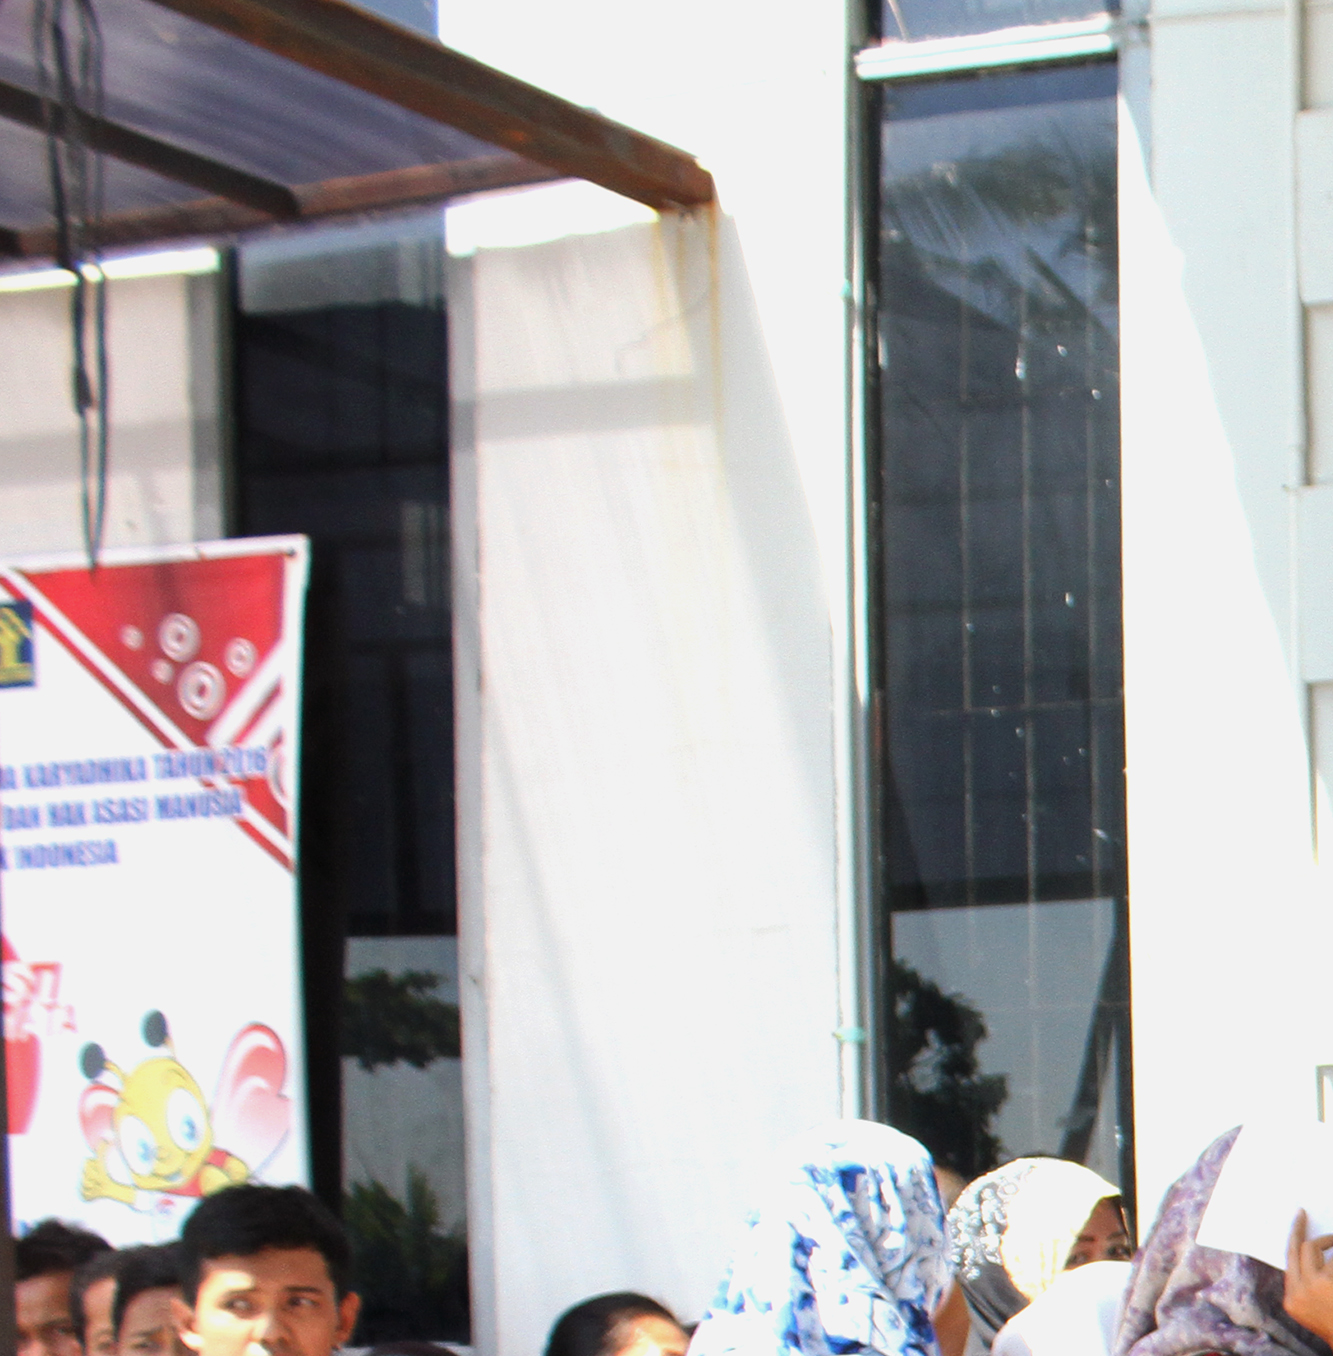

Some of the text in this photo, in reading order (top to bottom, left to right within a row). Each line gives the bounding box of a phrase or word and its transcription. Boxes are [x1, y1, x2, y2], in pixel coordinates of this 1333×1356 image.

[152, 750, 214, 779] TAHUN
[47, 800, 86, 828] HAK
[91, 797, 148, 824] ASASI
[154, 789, 242, 819] MANUSIA
[14, 839, 118, 869] INDONESIA
